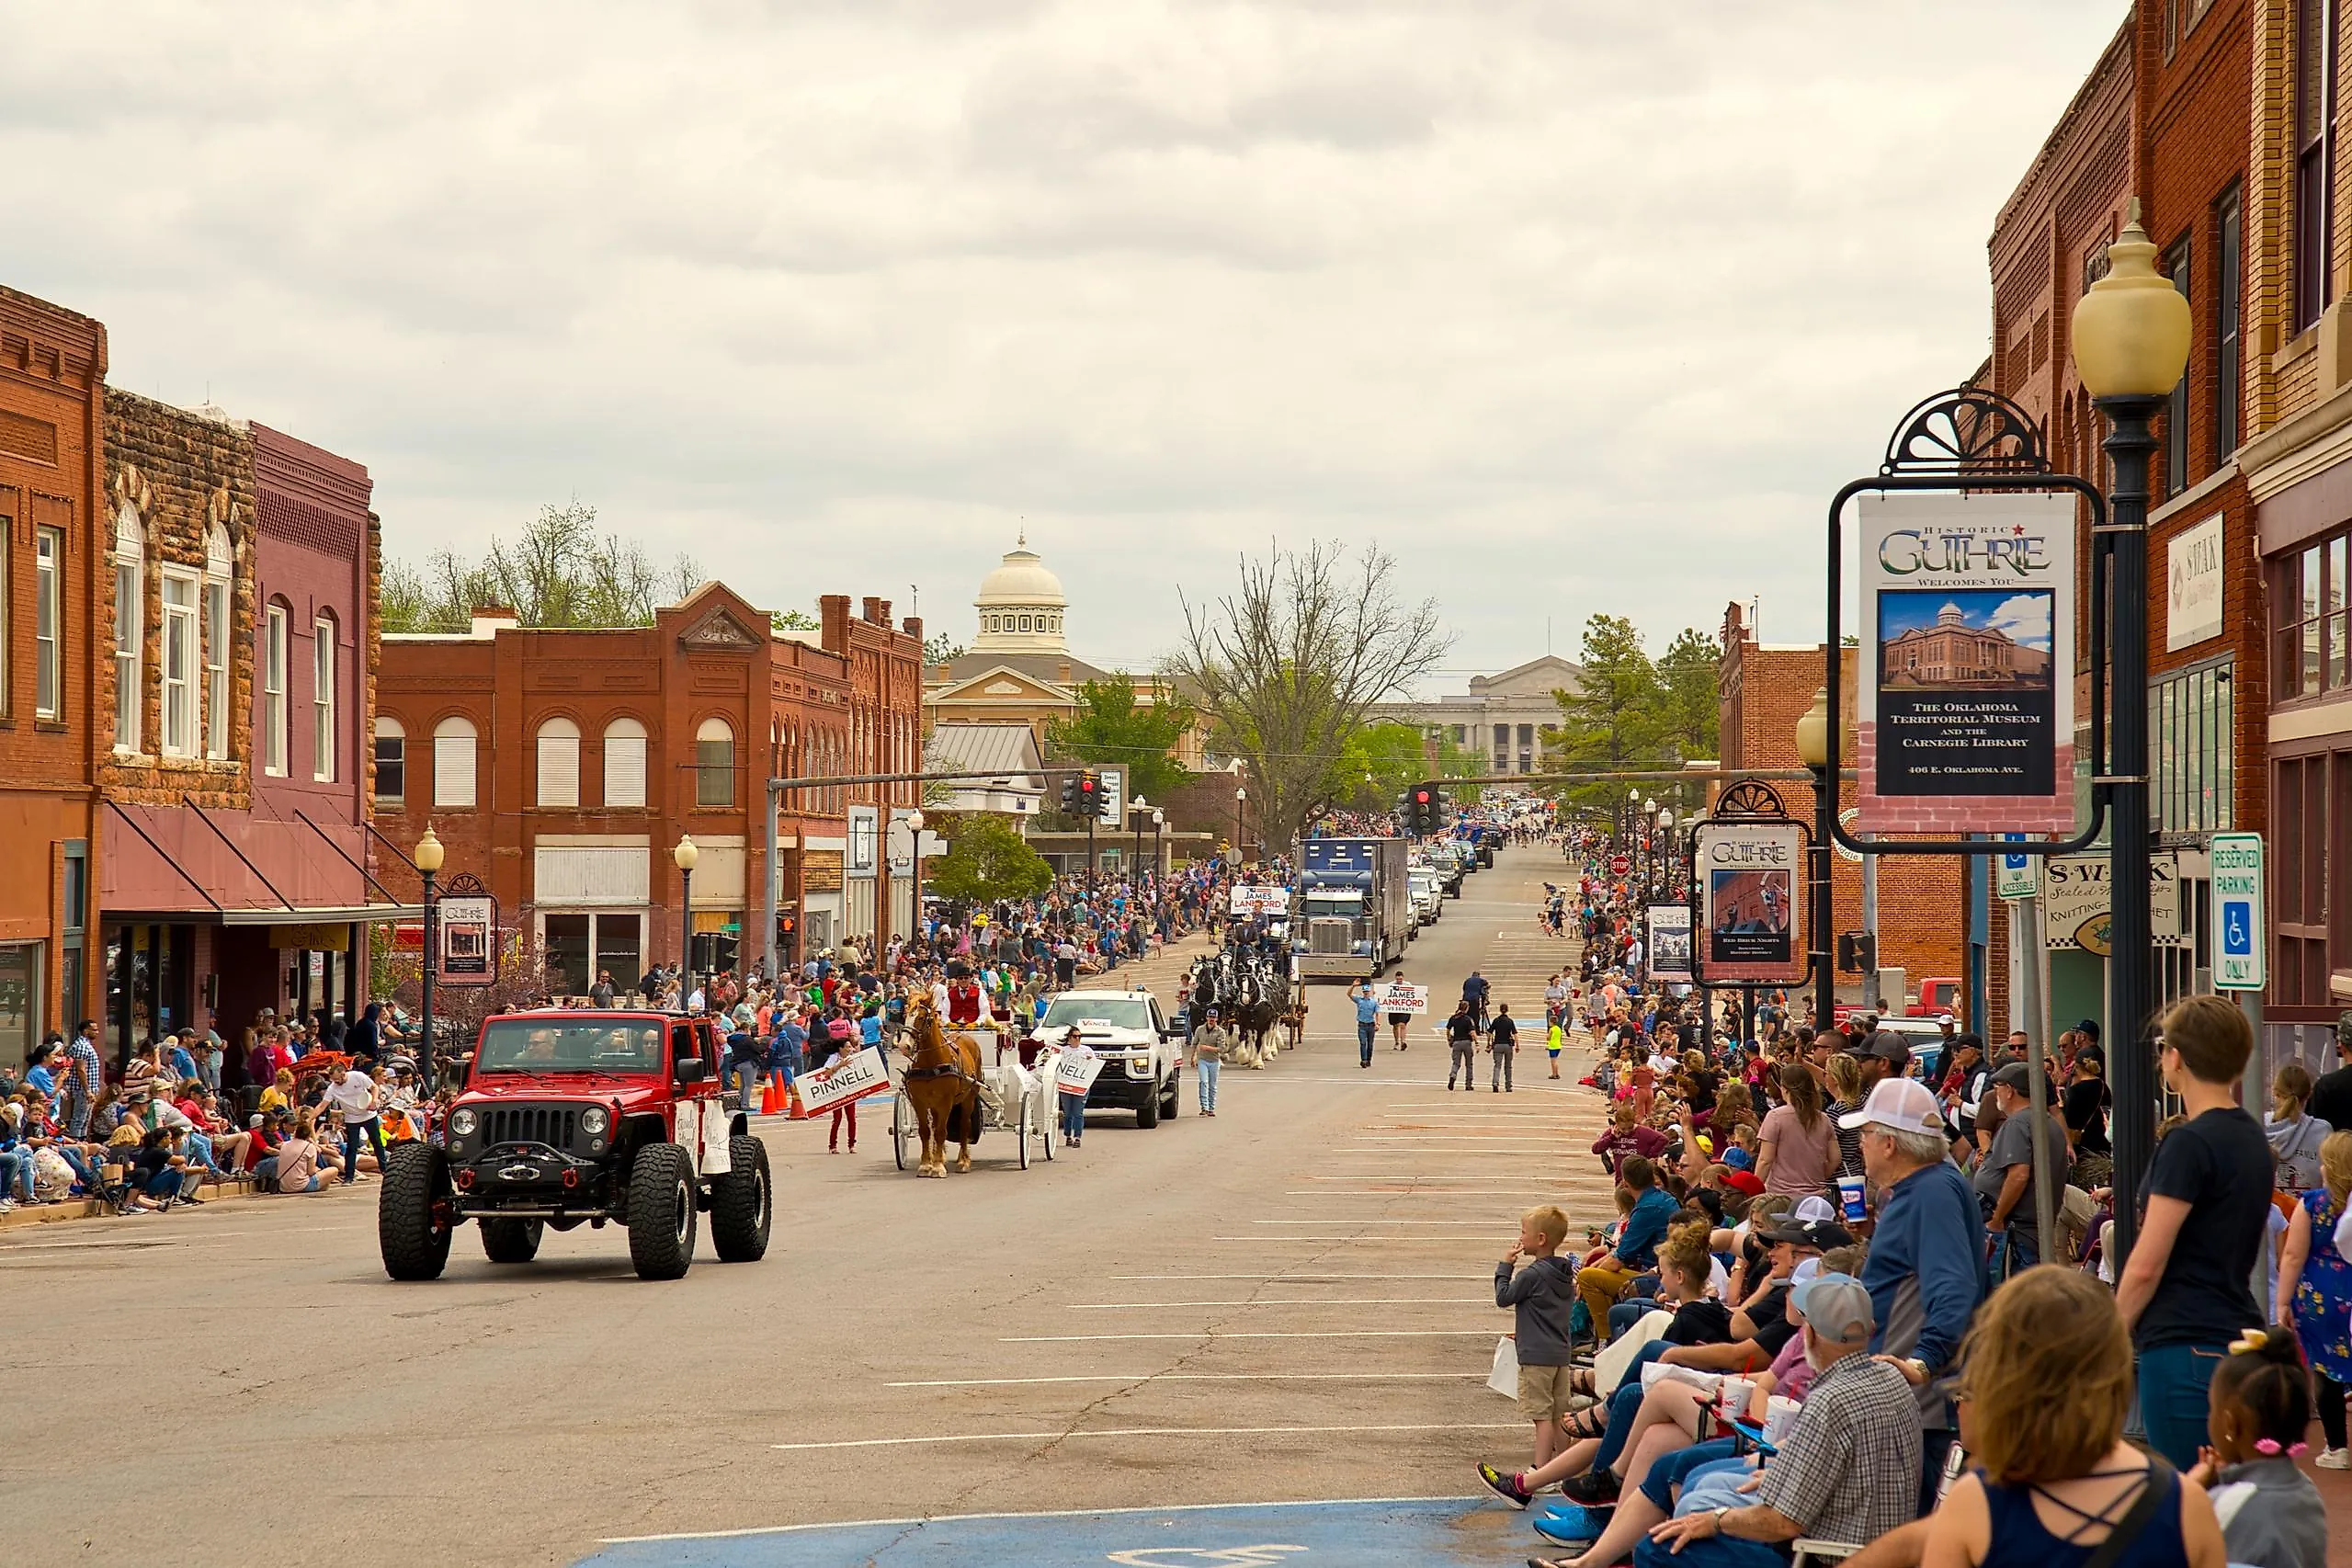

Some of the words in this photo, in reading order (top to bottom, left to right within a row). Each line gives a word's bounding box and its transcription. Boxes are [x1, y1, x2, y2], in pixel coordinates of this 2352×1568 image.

[1879, 529, 2052, 576] GUTHRIE
[1918, 578, 1986, 586] WELCOMES
[1991, 577, 2015, 586] YOU
[1913, 702, 1940, 712] THE
[1944, 702, 2019, 712] OKLAHOMA
[1890, 715, 1979, 724] TERRITORIAL
[1983, 714, 2040, 724] MUSEUM
[1903, 738, 1969, 747] CARNEGIE
[1972, 738, 2029, 747] LIBRARY
[1944, 766, 1998, 774] OKLAHOMA
[2001, 766, 2024, 774] AVE.
[1712, 842, 1788, 864] GUTHRIE
[2215, 849, 2258, 868] RESERVED
[2003, 881, 2034, 893] ACCESSIBLE
[2217, 876, 2255, 894] PARKING
[1244, 892, 1272, 900] JAMES
[1234, 900, 1281, 908] LANORD
[2051, 901, 2105, 923] KNITTING
[2226, 960, 2250, 979] ONLY
[1387, 989, 1415, 999] JAMES
[1378, 998, 1425, 1007] LANKFORD
[1055, 1062, 1086, 1079] NELL
[810, 1067, 874, 1099] PINNELL
